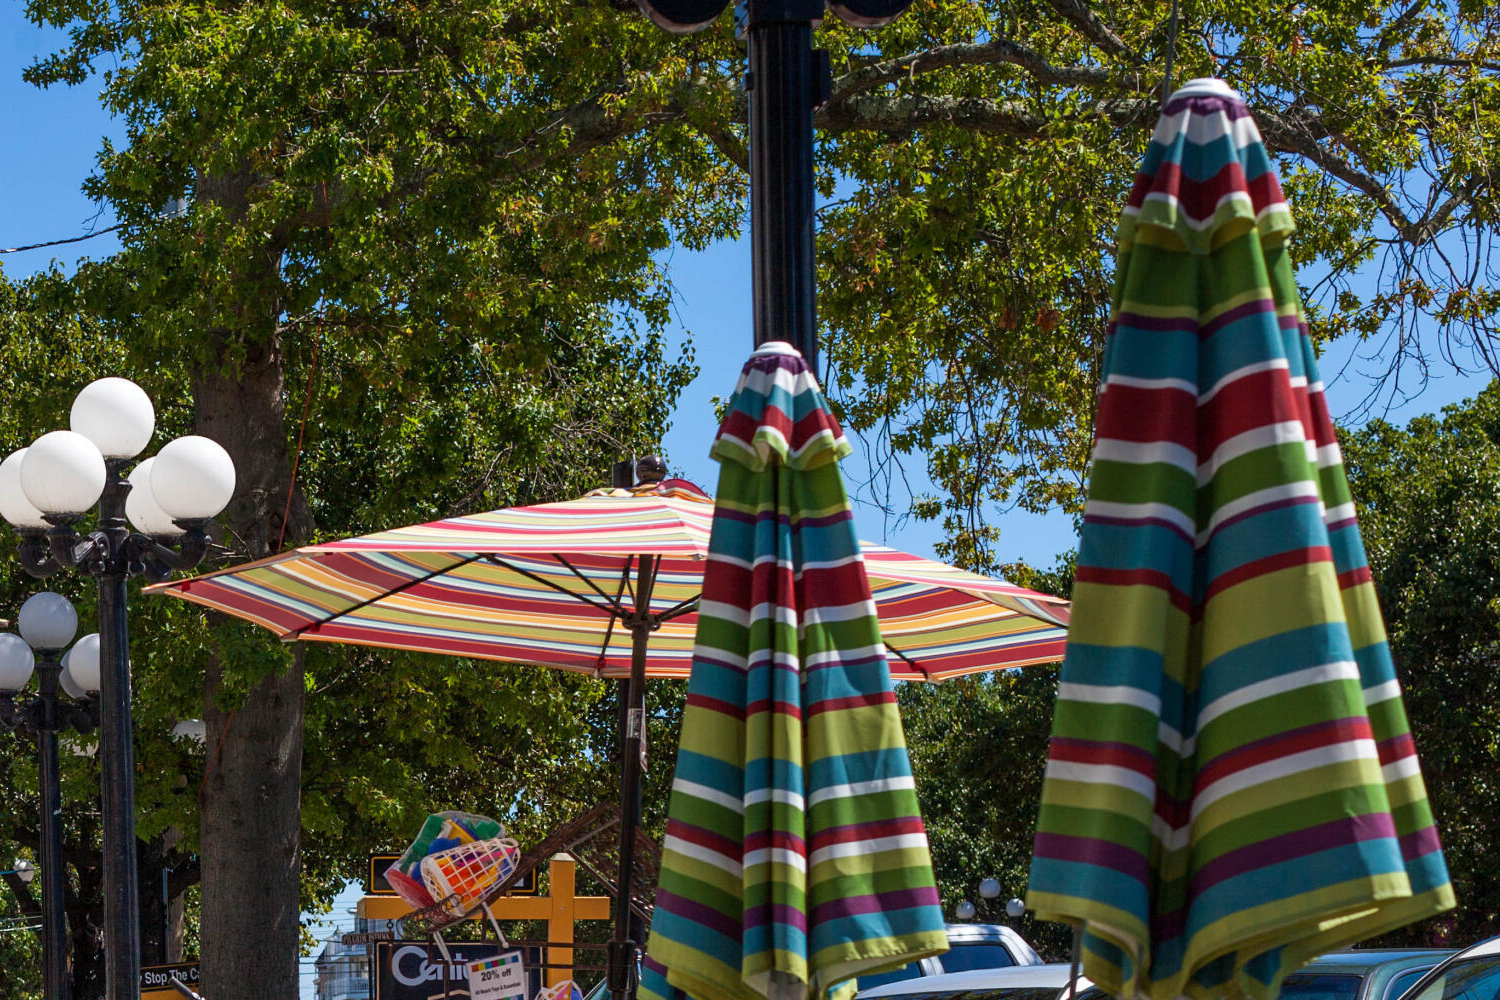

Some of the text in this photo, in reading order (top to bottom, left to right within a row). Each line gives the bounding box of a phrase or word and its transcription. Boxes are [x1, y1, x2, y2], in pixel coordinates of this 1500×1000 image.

[145, 971, 168, 986] Stop
[168, 968, 188, 981] The
[480, 968, 512, 982] 20% off
